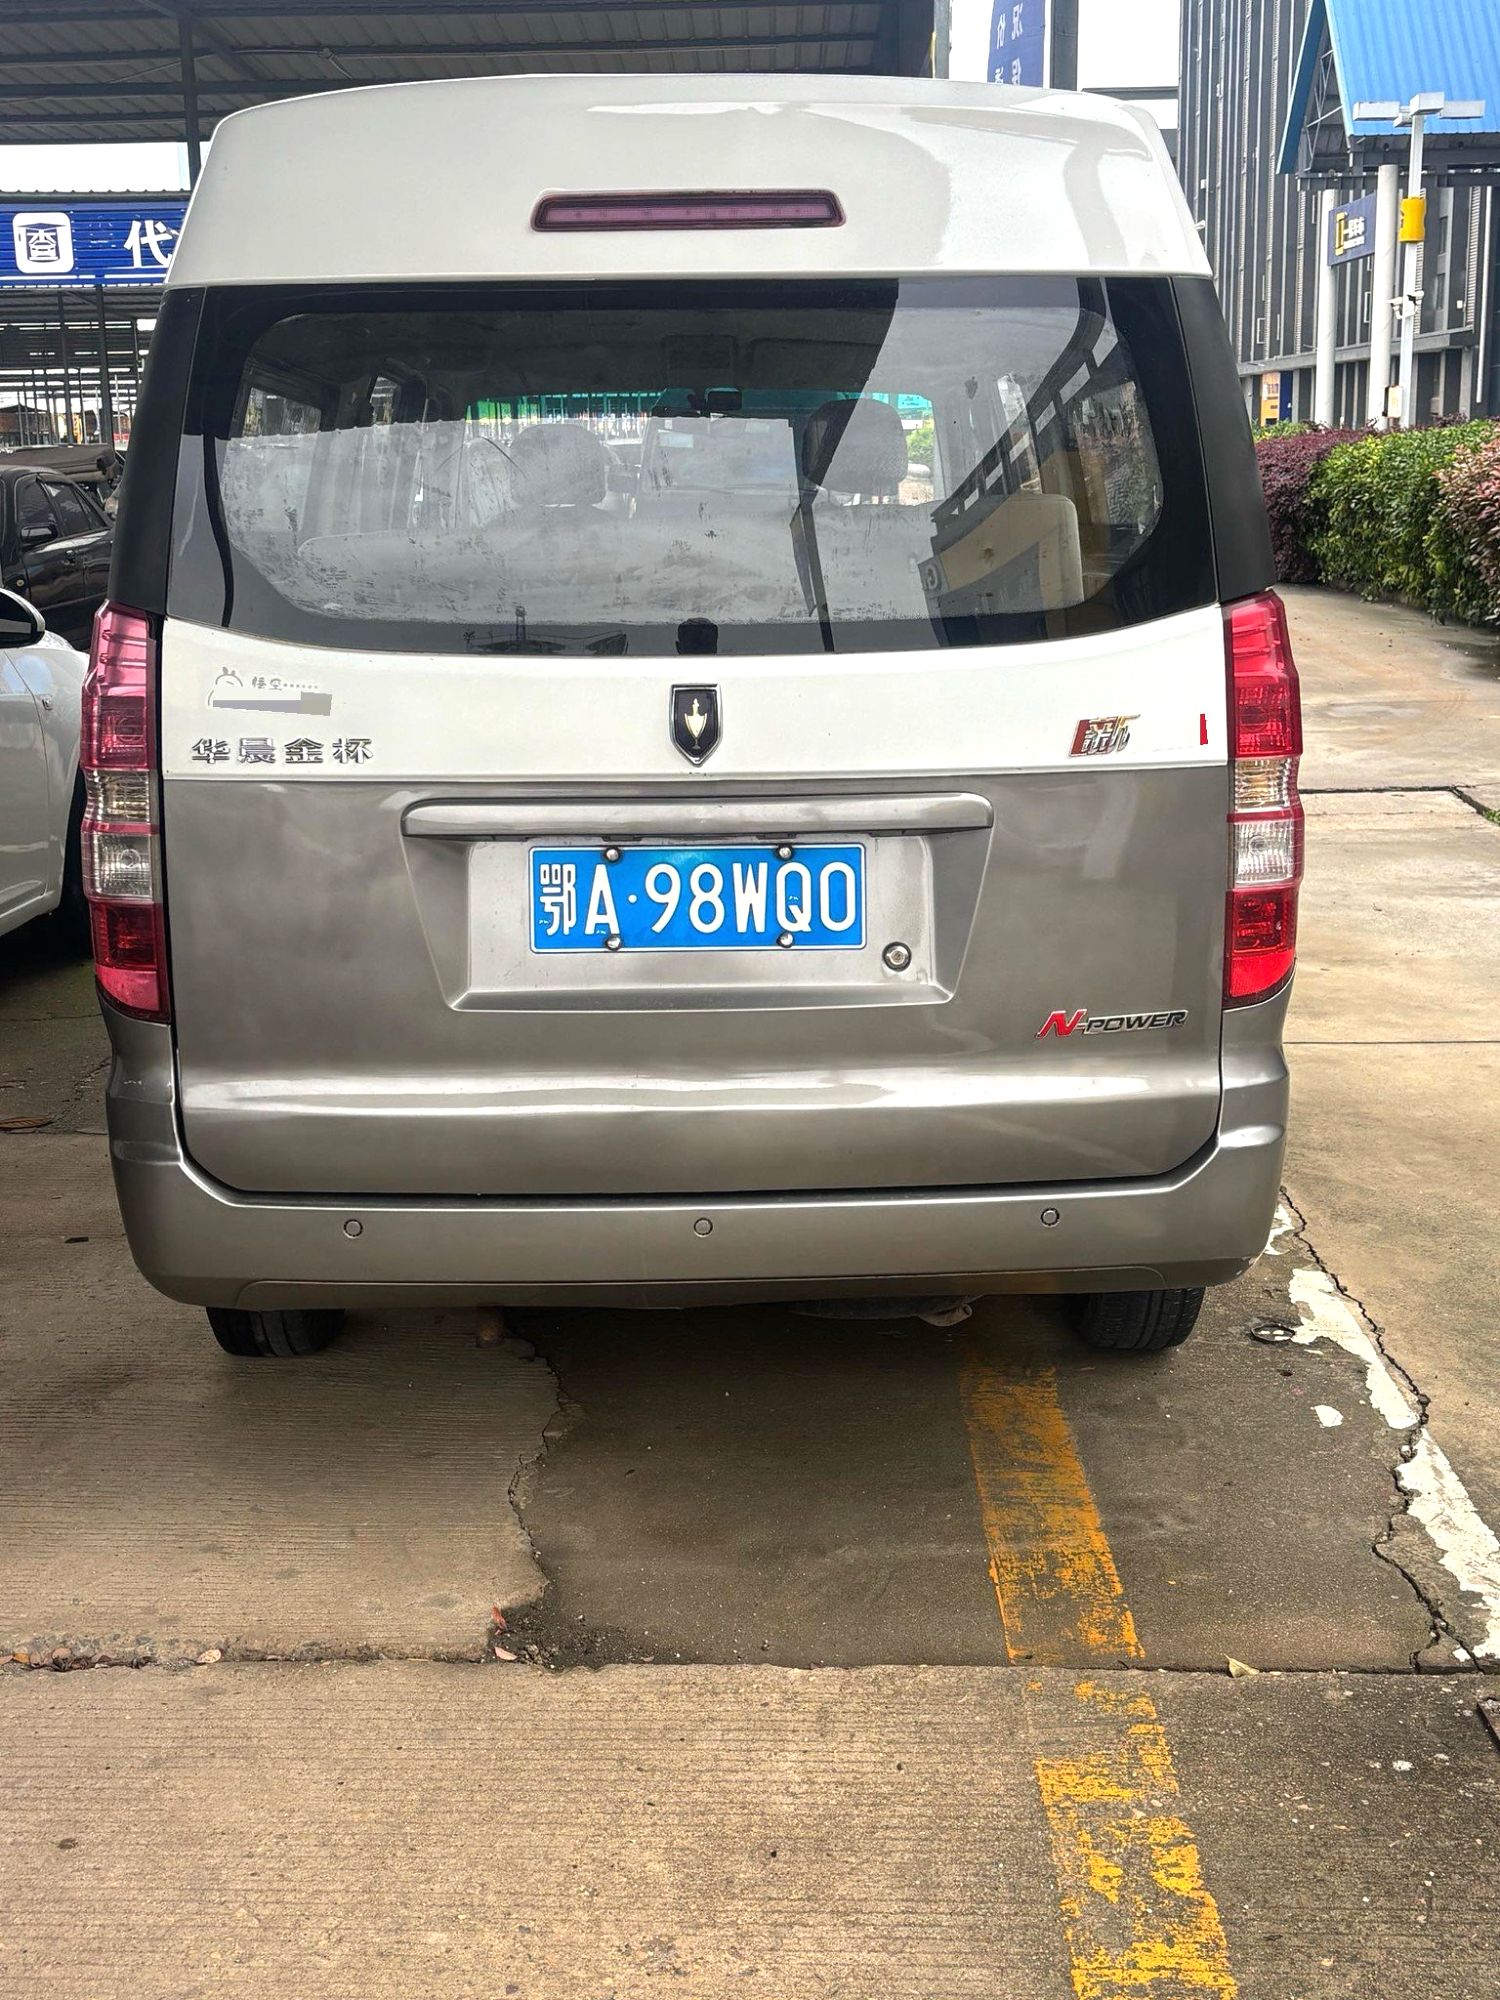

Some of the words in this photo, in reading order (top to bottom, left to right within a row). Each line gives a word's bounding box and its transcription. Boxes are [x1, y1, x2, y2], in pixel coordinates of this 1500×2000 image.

[192, 737, 374, 764] 华晨金杯
[1035, 1009, 1188, 1039] N-POWER
